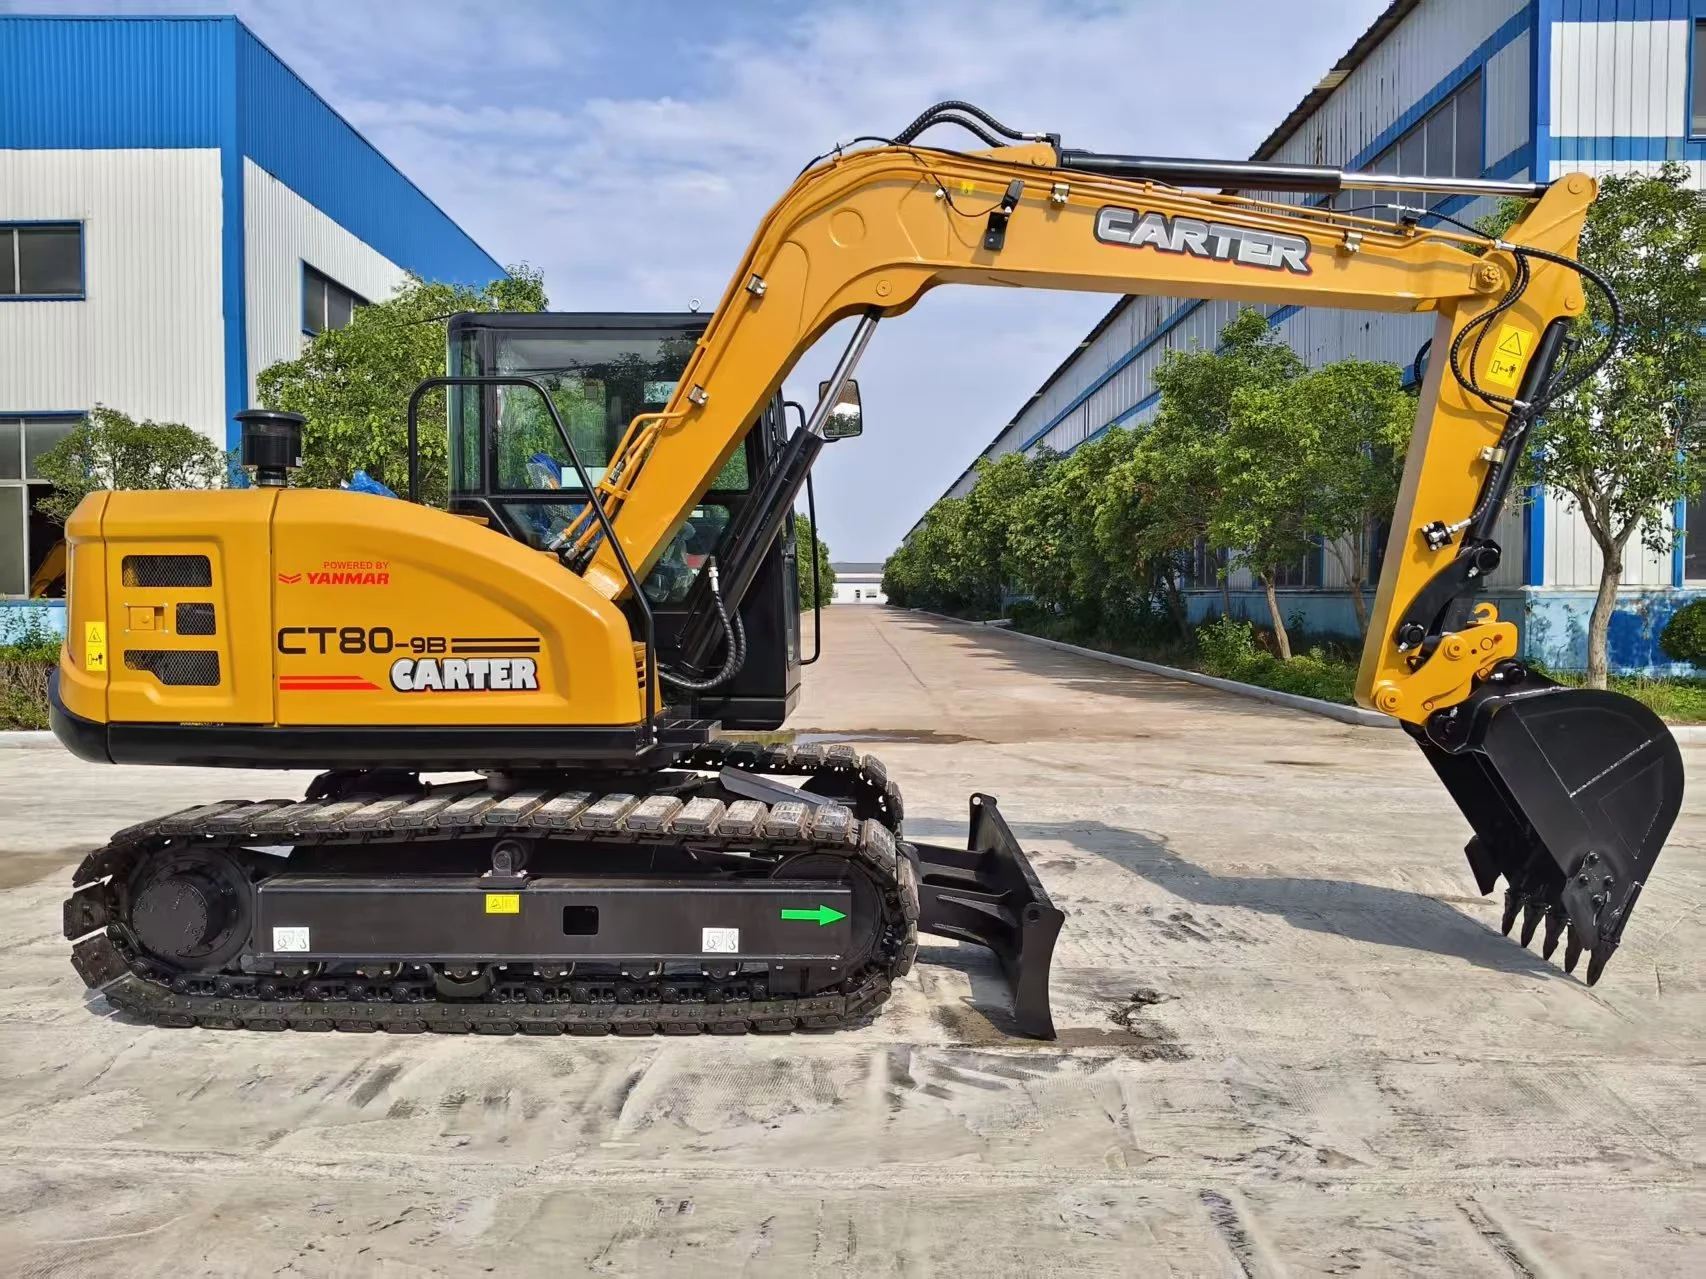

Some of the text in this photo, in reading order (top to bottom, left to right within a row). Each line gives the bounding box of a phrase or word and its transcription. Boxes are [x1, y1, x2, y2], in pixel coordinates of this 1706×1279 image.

[1096, 205, 1310, 273] CARTER
[306, 572, 390, 585] YANMAR
[323, 561, 389, 570] POWERED BY
[277, 626, 447, 654] CT80-9B
[390, 657, 539, 691] CARTER
